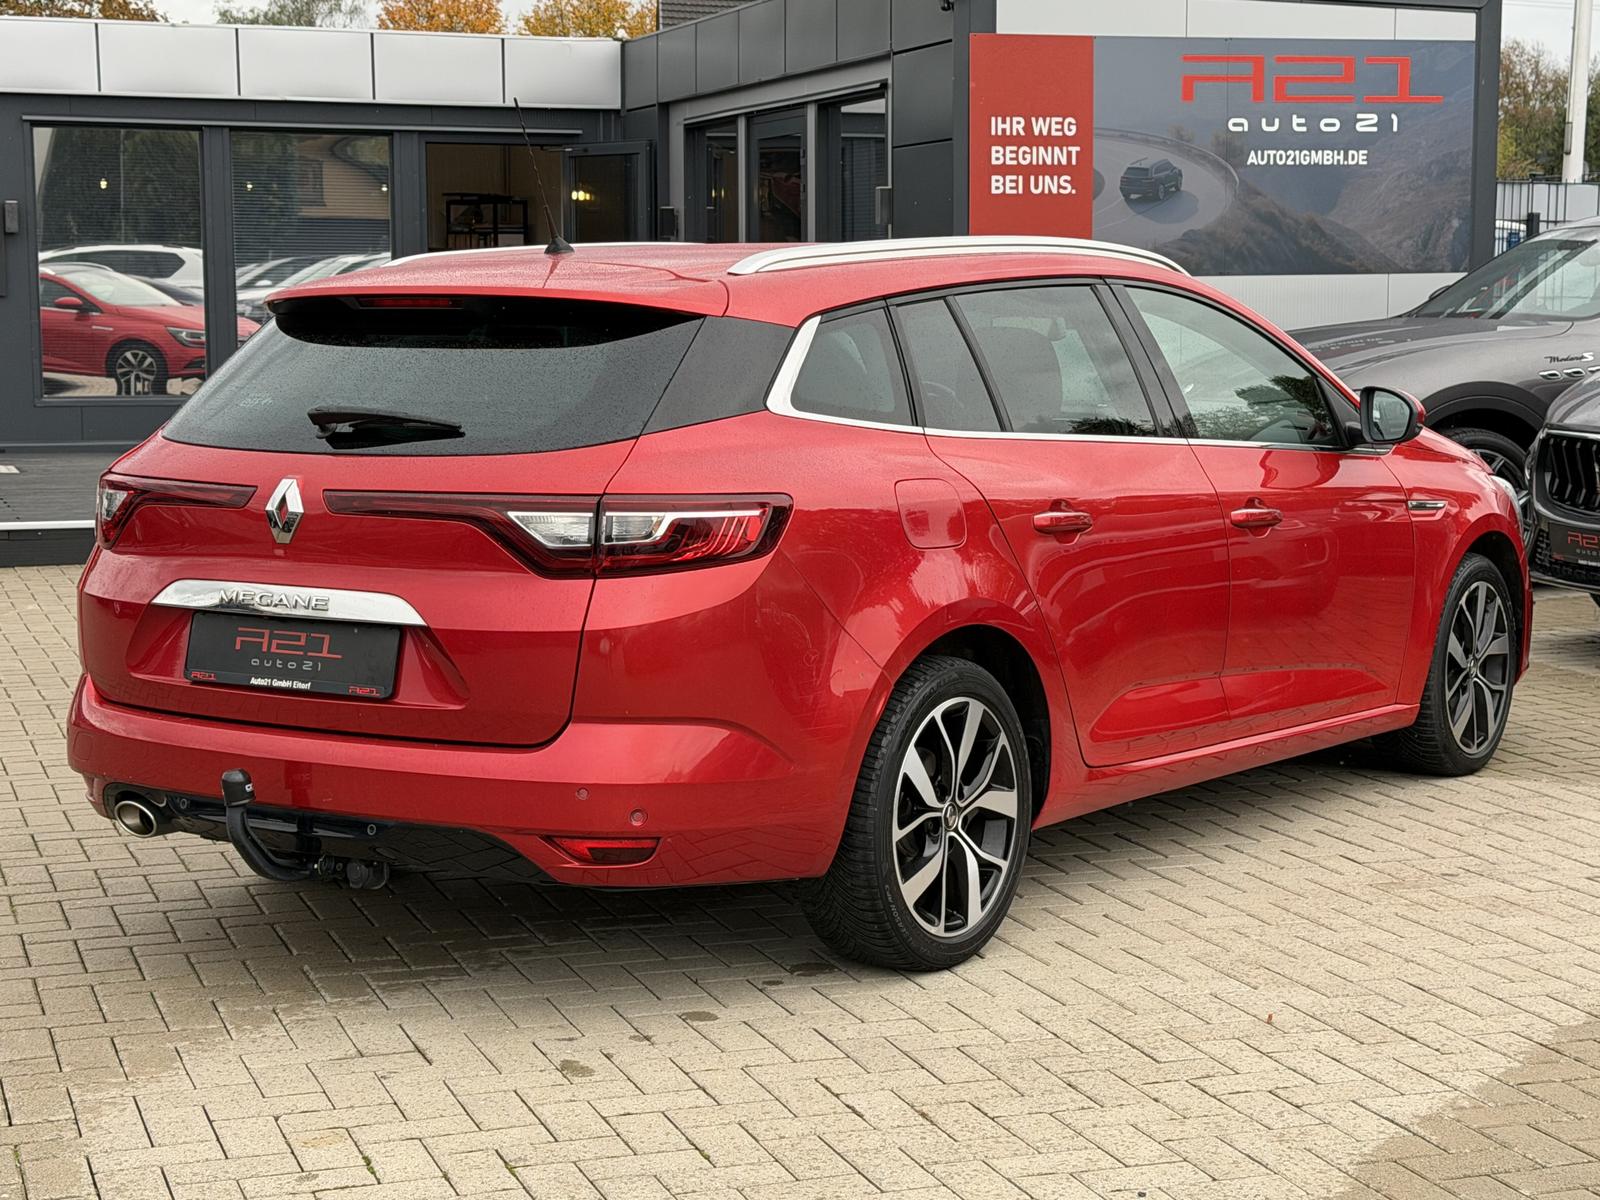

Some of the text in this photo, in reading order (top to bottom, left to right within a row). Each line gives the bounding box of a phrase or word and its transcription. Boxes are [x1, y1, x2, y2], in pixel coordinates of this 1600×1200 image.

[1181, 55, 1444, 103] A21
[991, 116, 1077, 136] IHR WEG
[991, 145, 1081, 166] BEGINNT
[1247, 150, 1368, 166] AUTO21GMBH.DE
[991, 175, 1077, 195] BEI UNS.
[219, 589, 330, 611] MEGANE
[235, 627, 343, 658] A21
[250, 677, 312, 690] Auto21 GmbH Eitorf
[348, 686, 380, 697] A21
